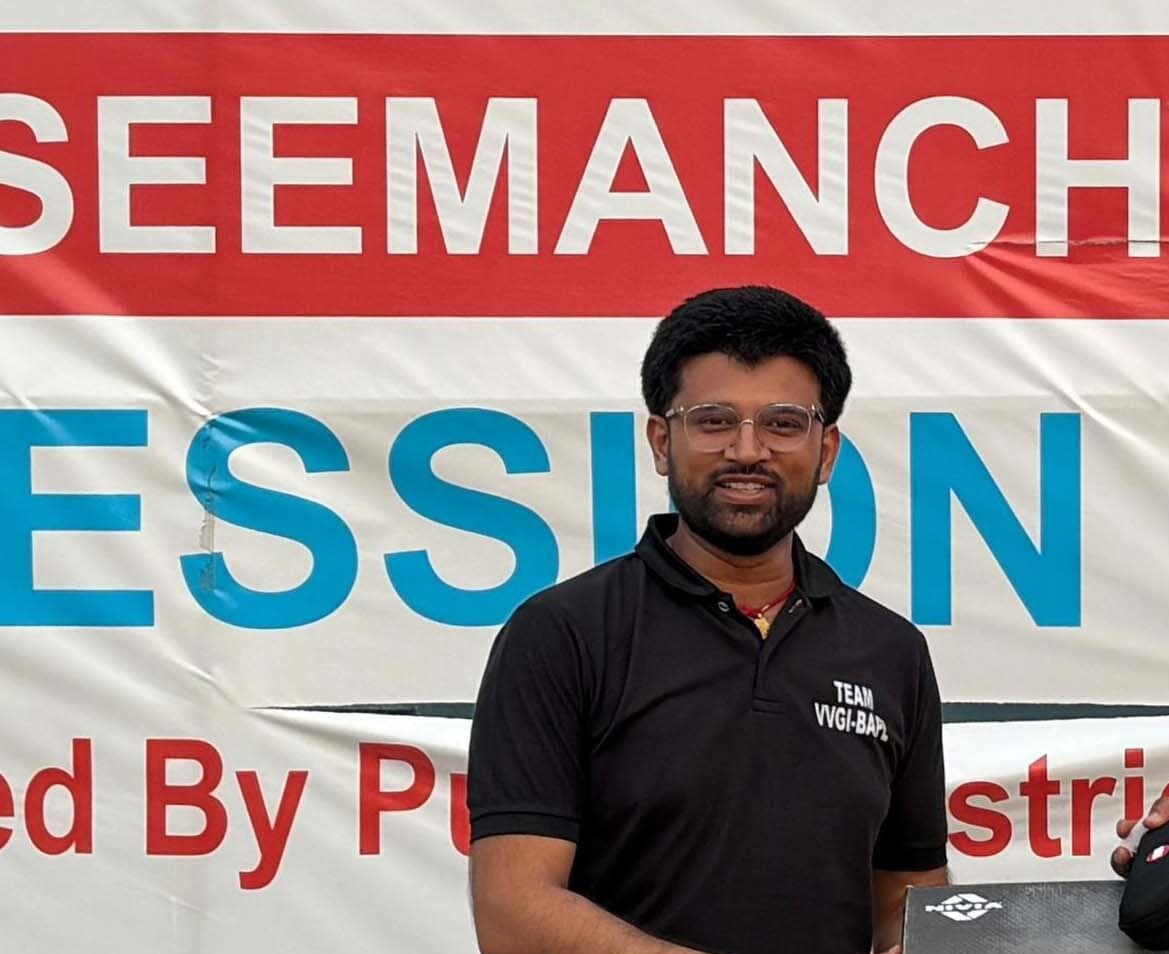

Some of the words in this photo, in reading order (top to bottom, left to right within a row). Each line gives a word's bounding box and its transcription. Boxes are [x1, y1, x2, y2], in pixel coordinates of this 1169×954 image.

[0, 406, 1082, 630] ESSIN
[833, 680, 874, 710] TEAM
[0, 737, 94, 856] d
[145, 738, 309, 890] By
